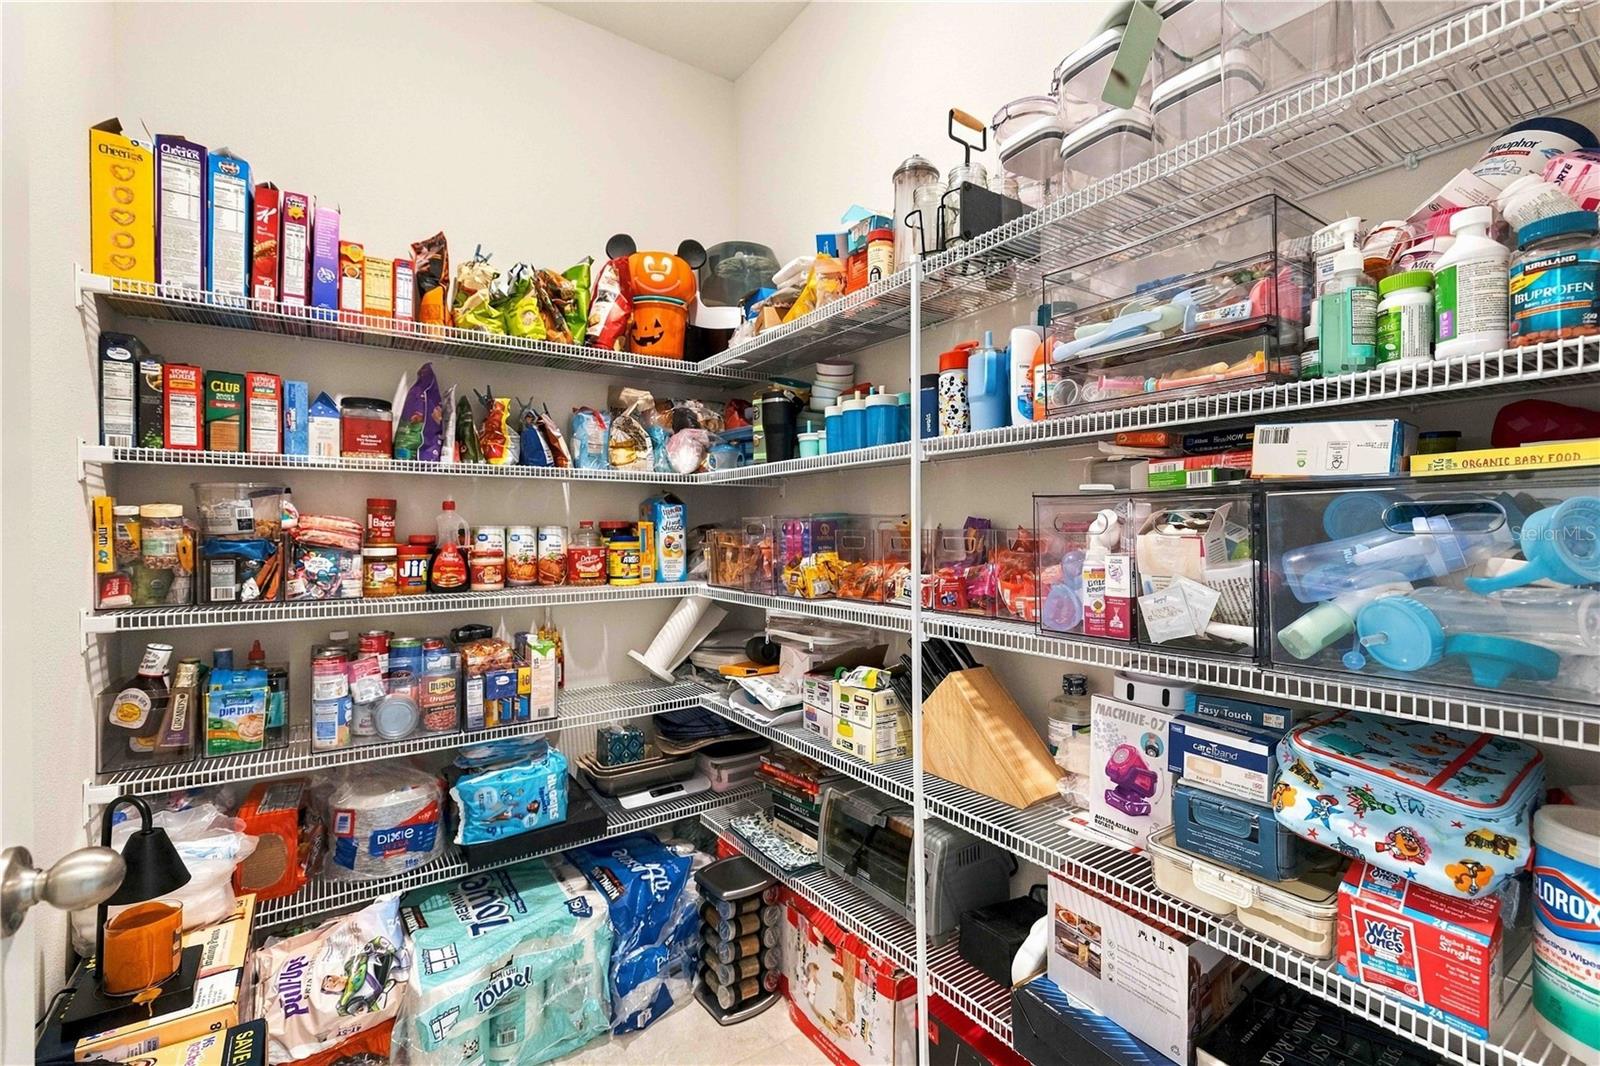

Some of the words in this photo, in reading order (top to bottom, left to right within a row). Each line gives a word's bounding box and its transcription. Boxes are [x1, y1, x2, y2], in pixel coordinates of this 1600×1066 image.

[98, 143, 144, 163] Cheerios
[160, 143, 200, 161] Cheerios
[1524, 255, 1577, 272] KIRKLAND
[1514, 282, 1594, 305] IBUPROFEN
[210, 380, 241, 393] CLUB
[1462, 457, 1510, 469] ORGANIC
[1515, 455, 1544, 465] BABY
[1548, 452, 1582, 463] FOOD
[399, 560, 427, 577] Jif
[219, 707, 236, 718] DIP
[236, 705, 255, 716] MIX
[1095, 703, 1168, 732] MACHINE-07
[1198, 704, 1220, 717] Easy
[1223, 708, 1253, 722] Touch
[458, 874, 516, 938] Towe
[1366, 920, 1403, 943] Wet
[1366, 932, 1403, 954] Ones
[1439, 941, 1482, 966] Singles
[474, 965, 532, 1012] Towel
[210, 1021, 222, 1032] 8
[232, 1029, 254, 1065] SAVE
